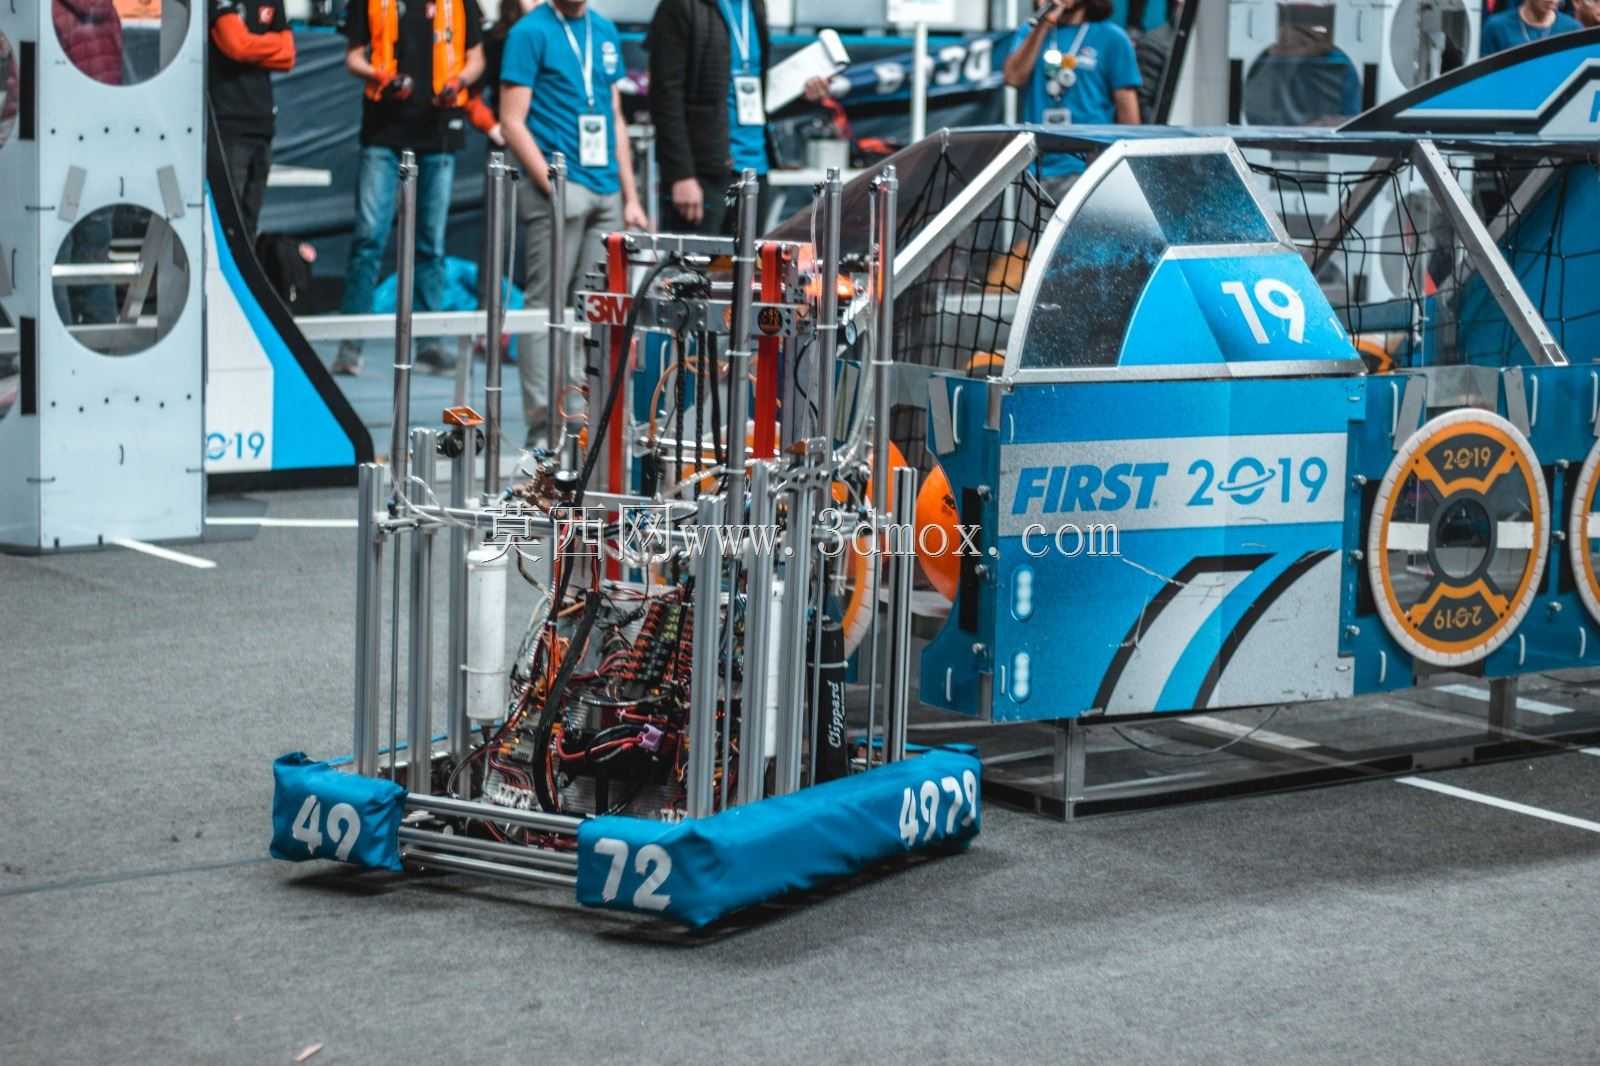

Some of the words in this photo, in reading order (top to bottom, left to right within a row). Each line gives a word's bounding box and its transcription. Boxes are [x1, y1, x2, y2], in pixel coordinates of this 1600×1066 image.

[586, 295, 632, 324] 3M
[1220, 279, 1305, 344] 19
[1012, 463, 1169, 515] FIRST
[1186, 456, 1328, 507] 2019
[1443, 447, 1491, 471] 2019
[1433, 605, 1482, 630] 2019
[827, 680, 844, 748] Clippard
[292, 794, 361, 862] 49
[593, 837, 672, 911] 72
